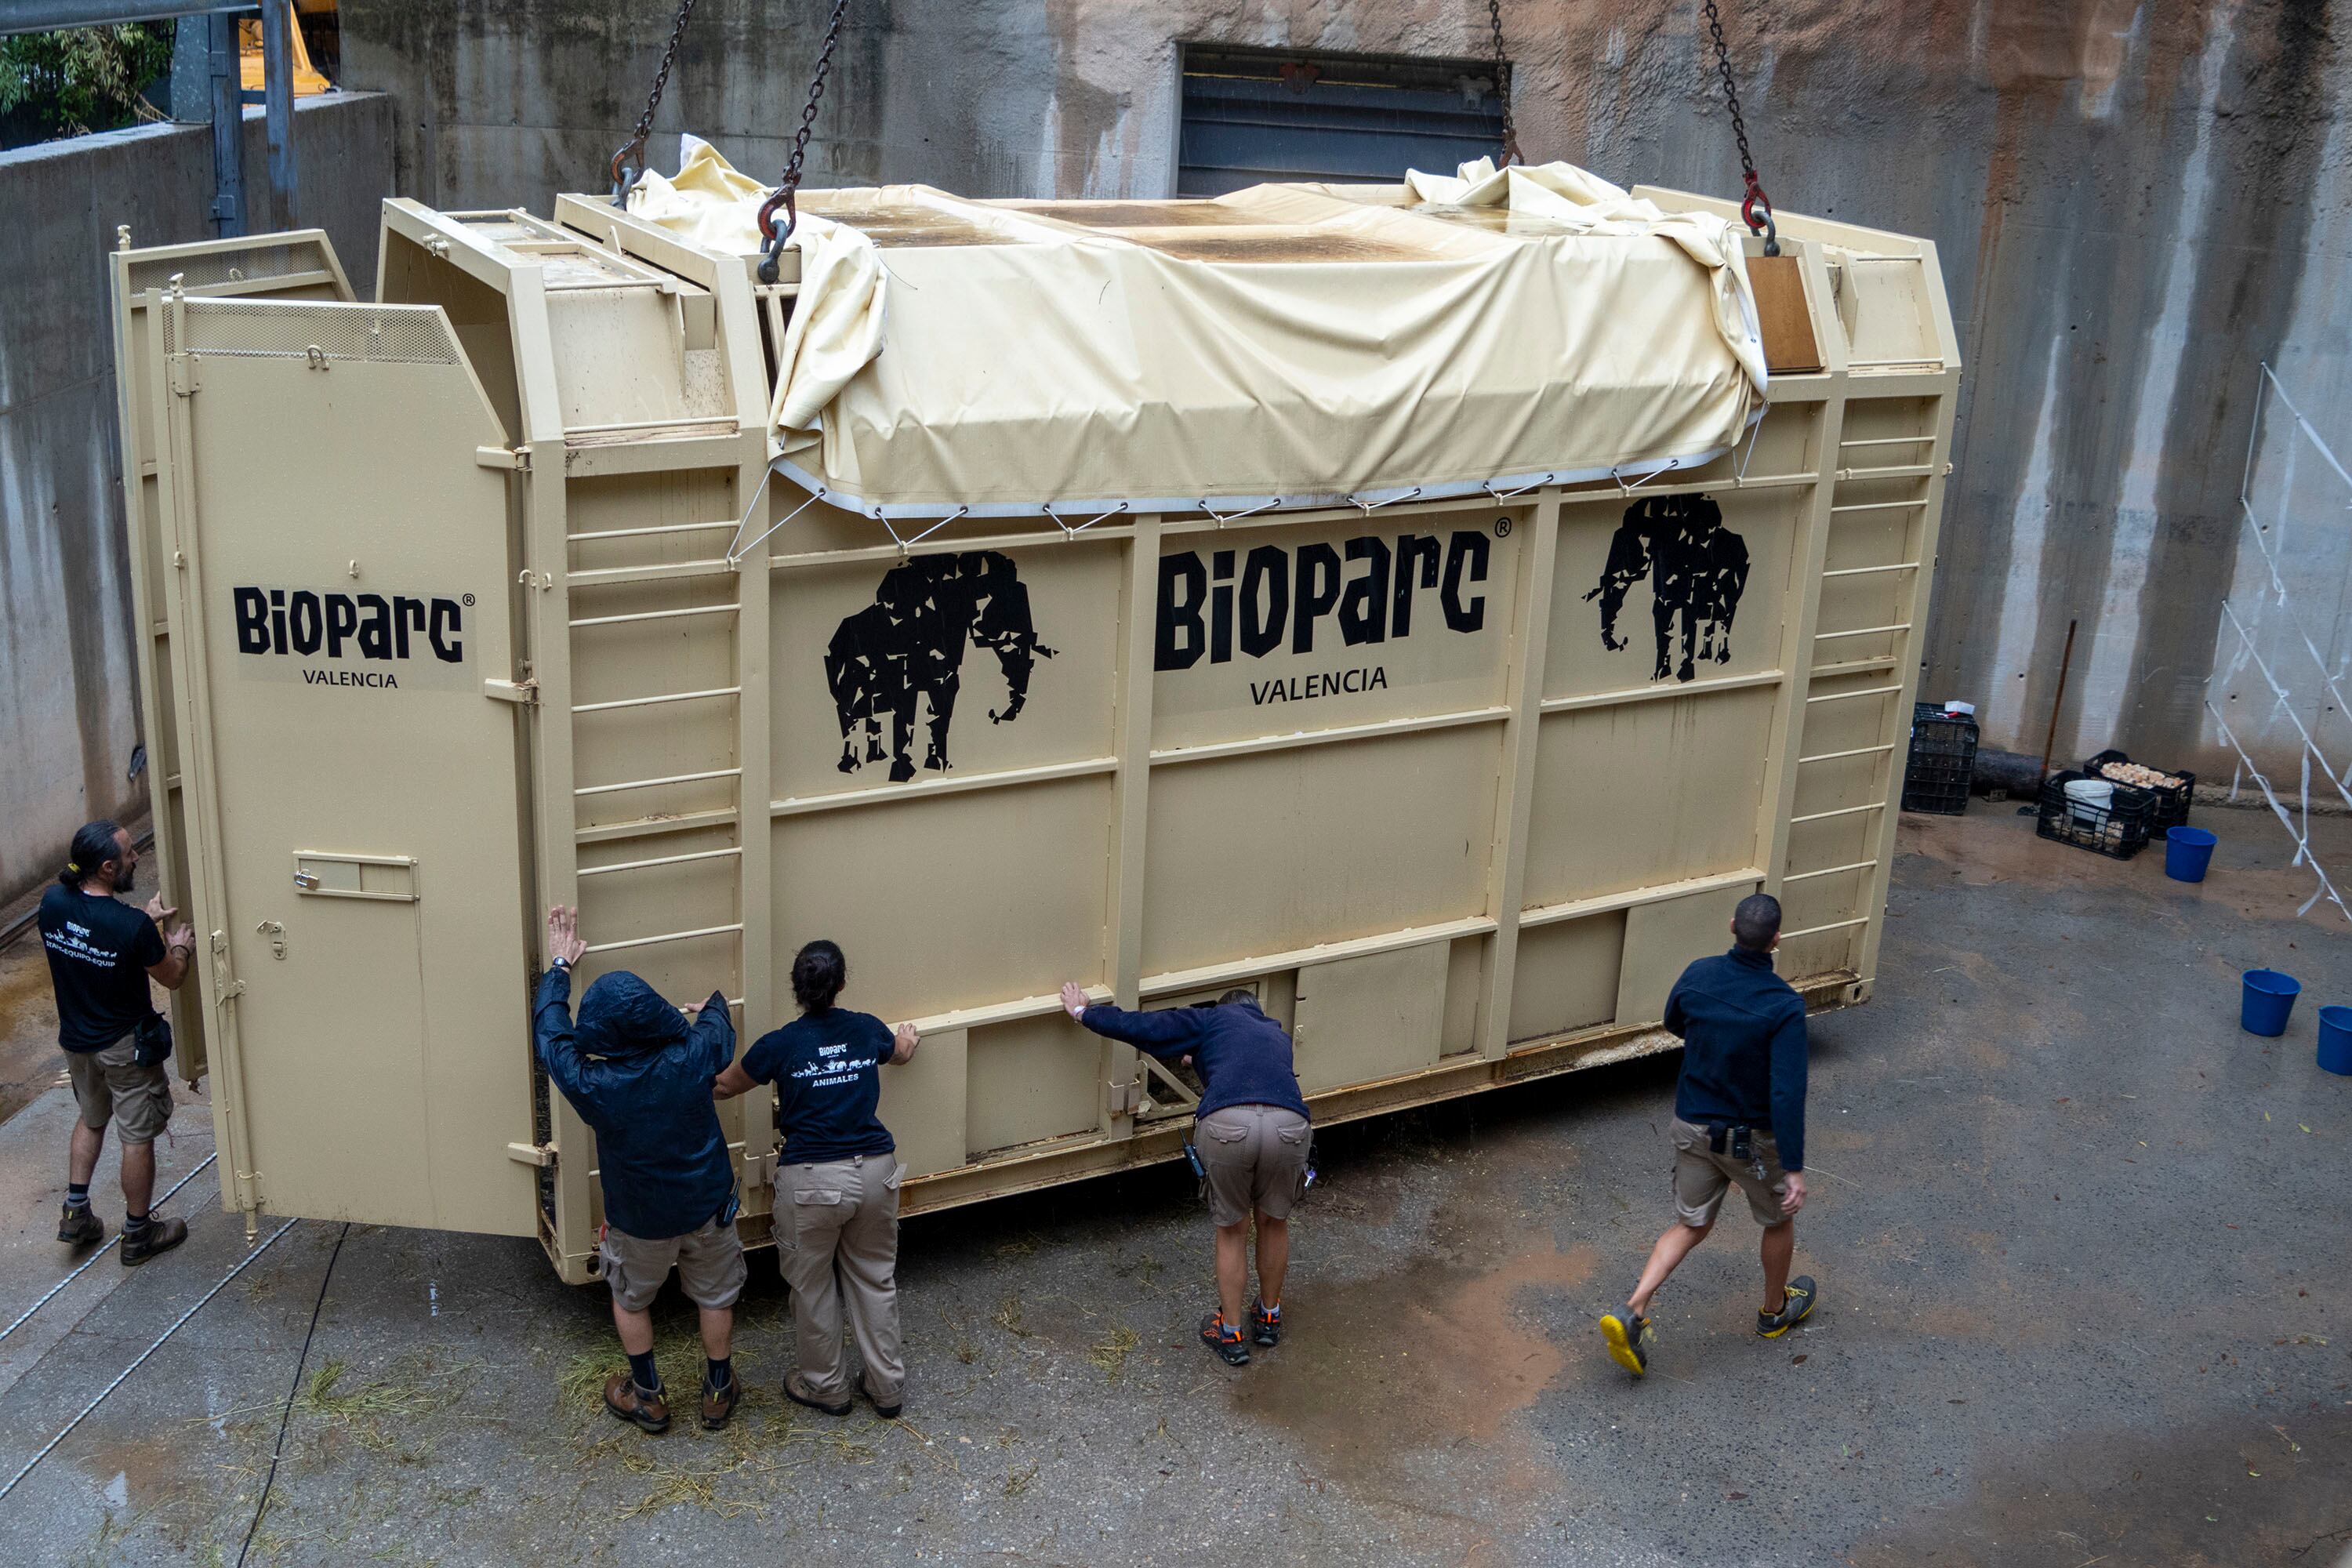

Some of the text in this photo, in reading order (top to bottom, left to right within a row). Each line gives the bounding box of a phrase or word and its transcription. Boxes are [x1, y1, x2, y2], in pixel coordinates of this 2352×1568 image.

[303, 670, 397, 688] VALENCIA
[1250, 666, 1388, 705] VALENCIA
[812, 1073, 859, 1087] ANIMALES
